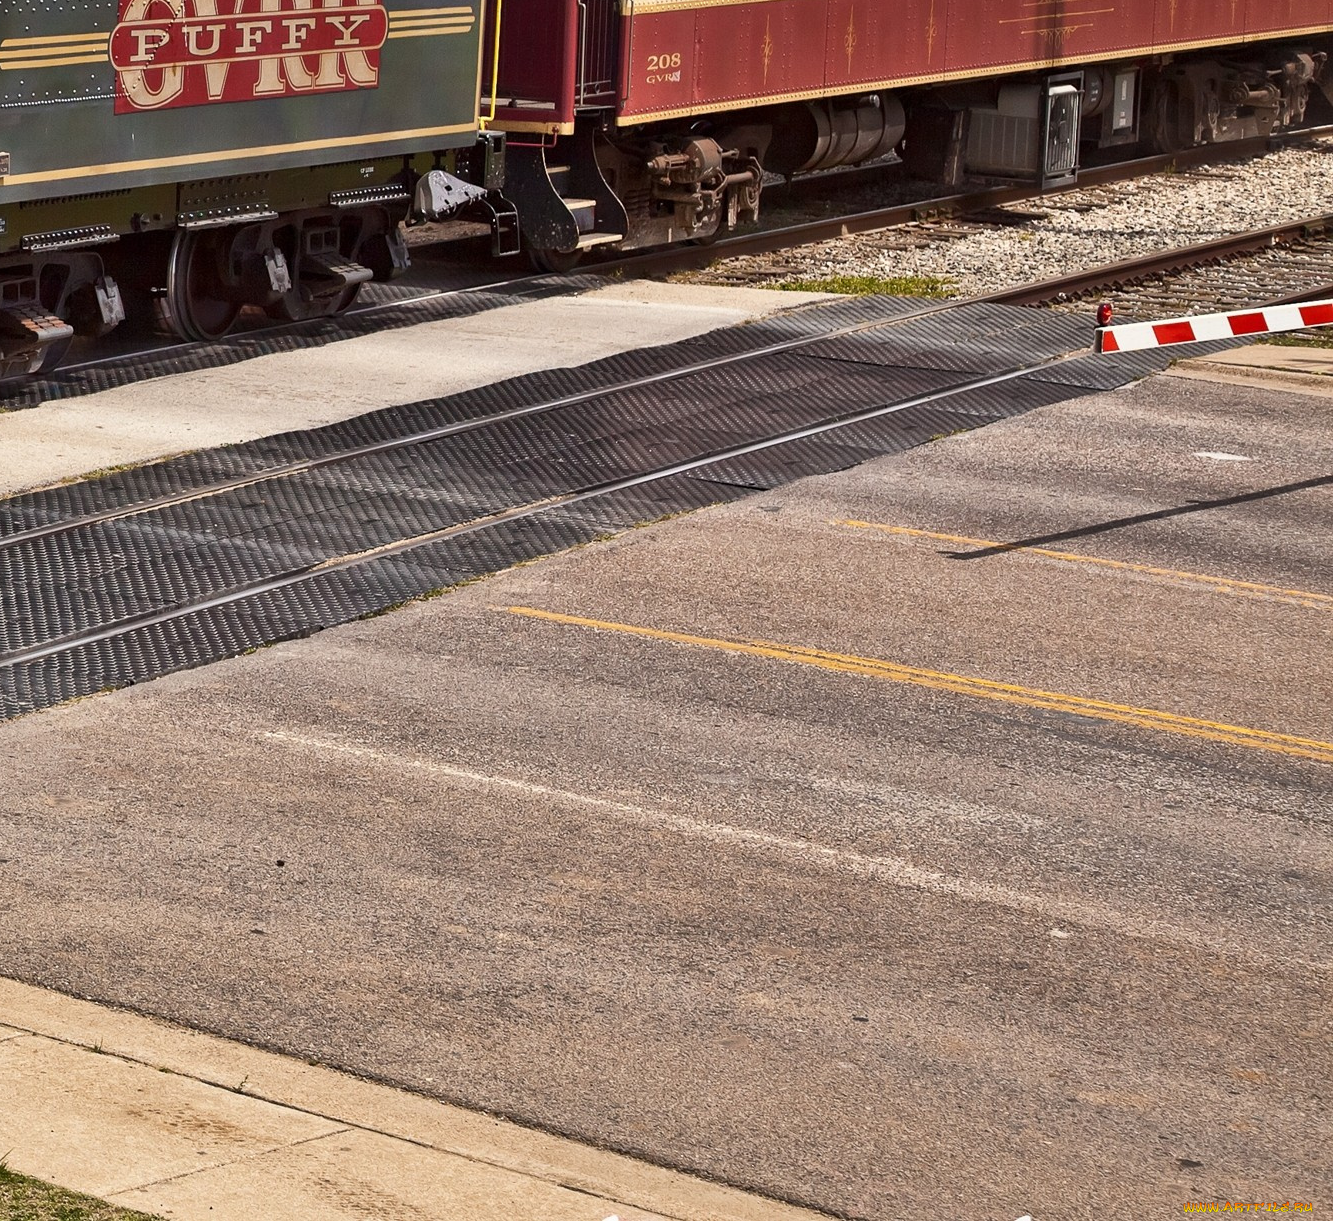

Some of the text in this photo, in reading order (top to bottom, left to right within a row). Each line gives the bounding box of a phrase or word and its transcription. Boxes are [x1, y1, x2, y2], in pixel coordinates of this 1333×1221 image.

[129, 14, 371, 62] PUFFY
[646, 52, 681, 71] 208
[646, 73, 674, 84] GVR
